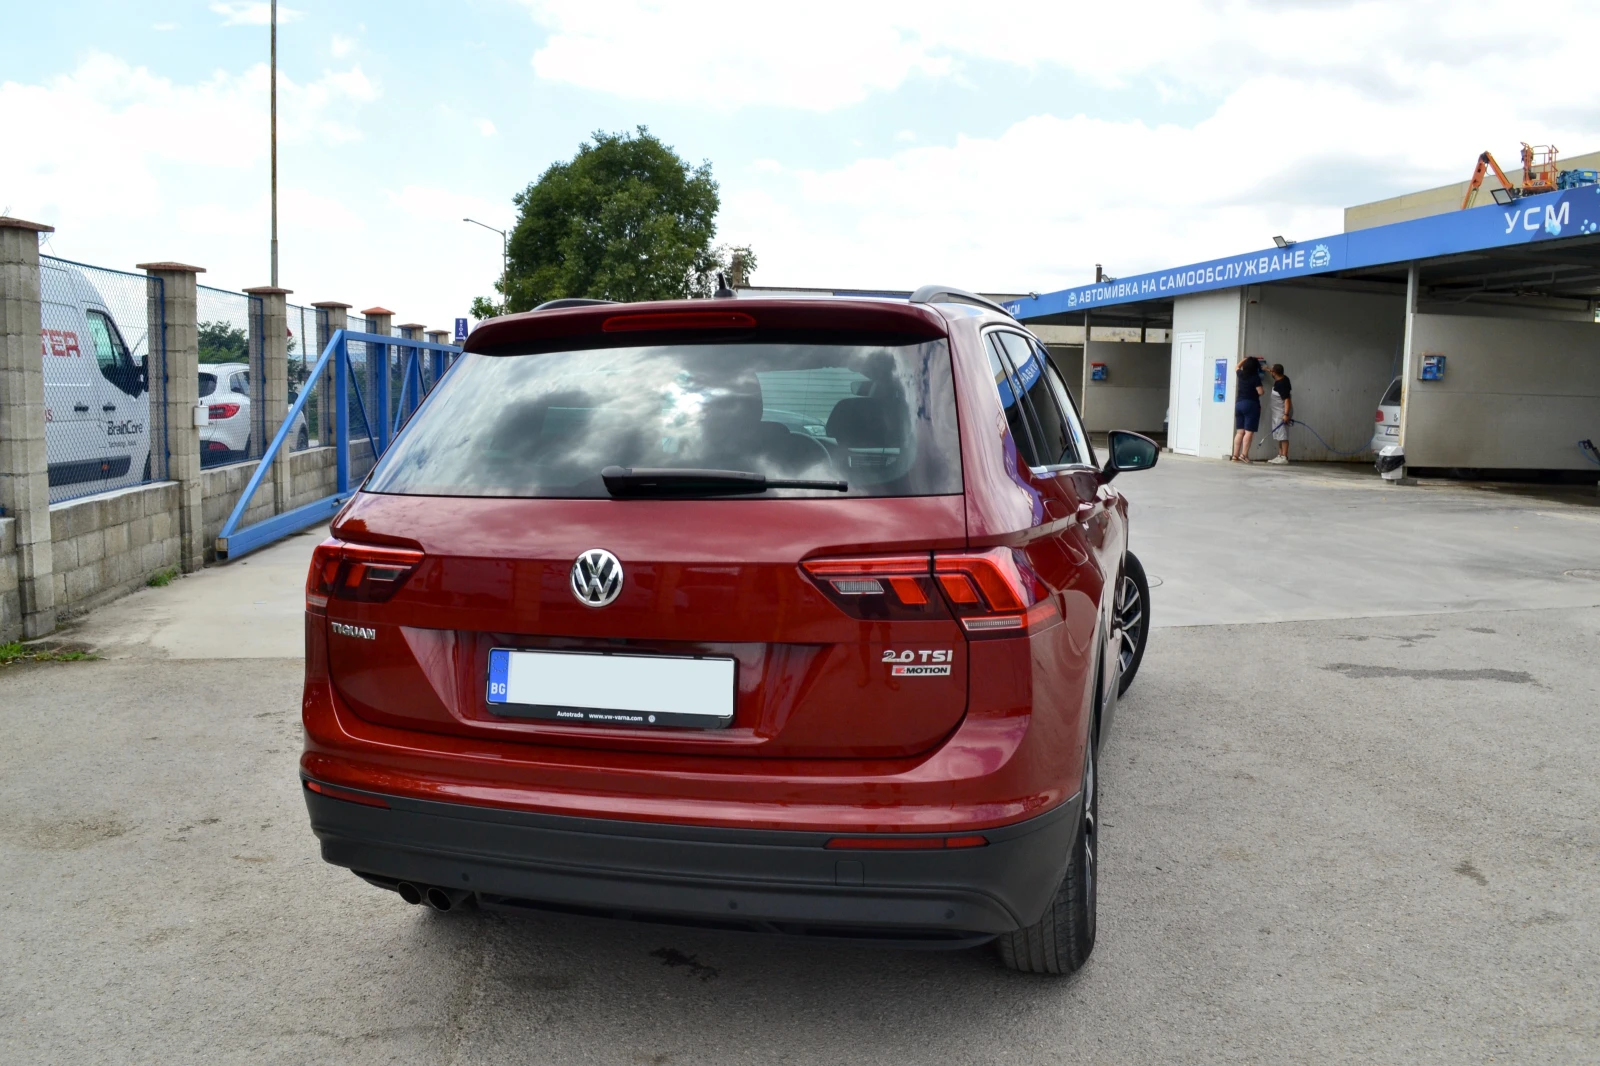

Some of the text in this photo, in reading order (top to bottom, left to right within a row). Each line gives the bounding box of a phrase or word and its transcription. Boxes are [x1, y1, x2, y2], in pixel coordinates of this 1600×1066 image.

[1078, 250, 1305, 304] АВТОМИВКА НА САМООБСЛУЖВАНЕ
[107, 420, 143, 436] BrainCore
[331, 621, 376, 640] TIGUAN
[881, 649, 954, 663] 2.0 TSI
[490, 682, 506, 695] BG
[588, 713, 643, 722] www.vw-varna.com
